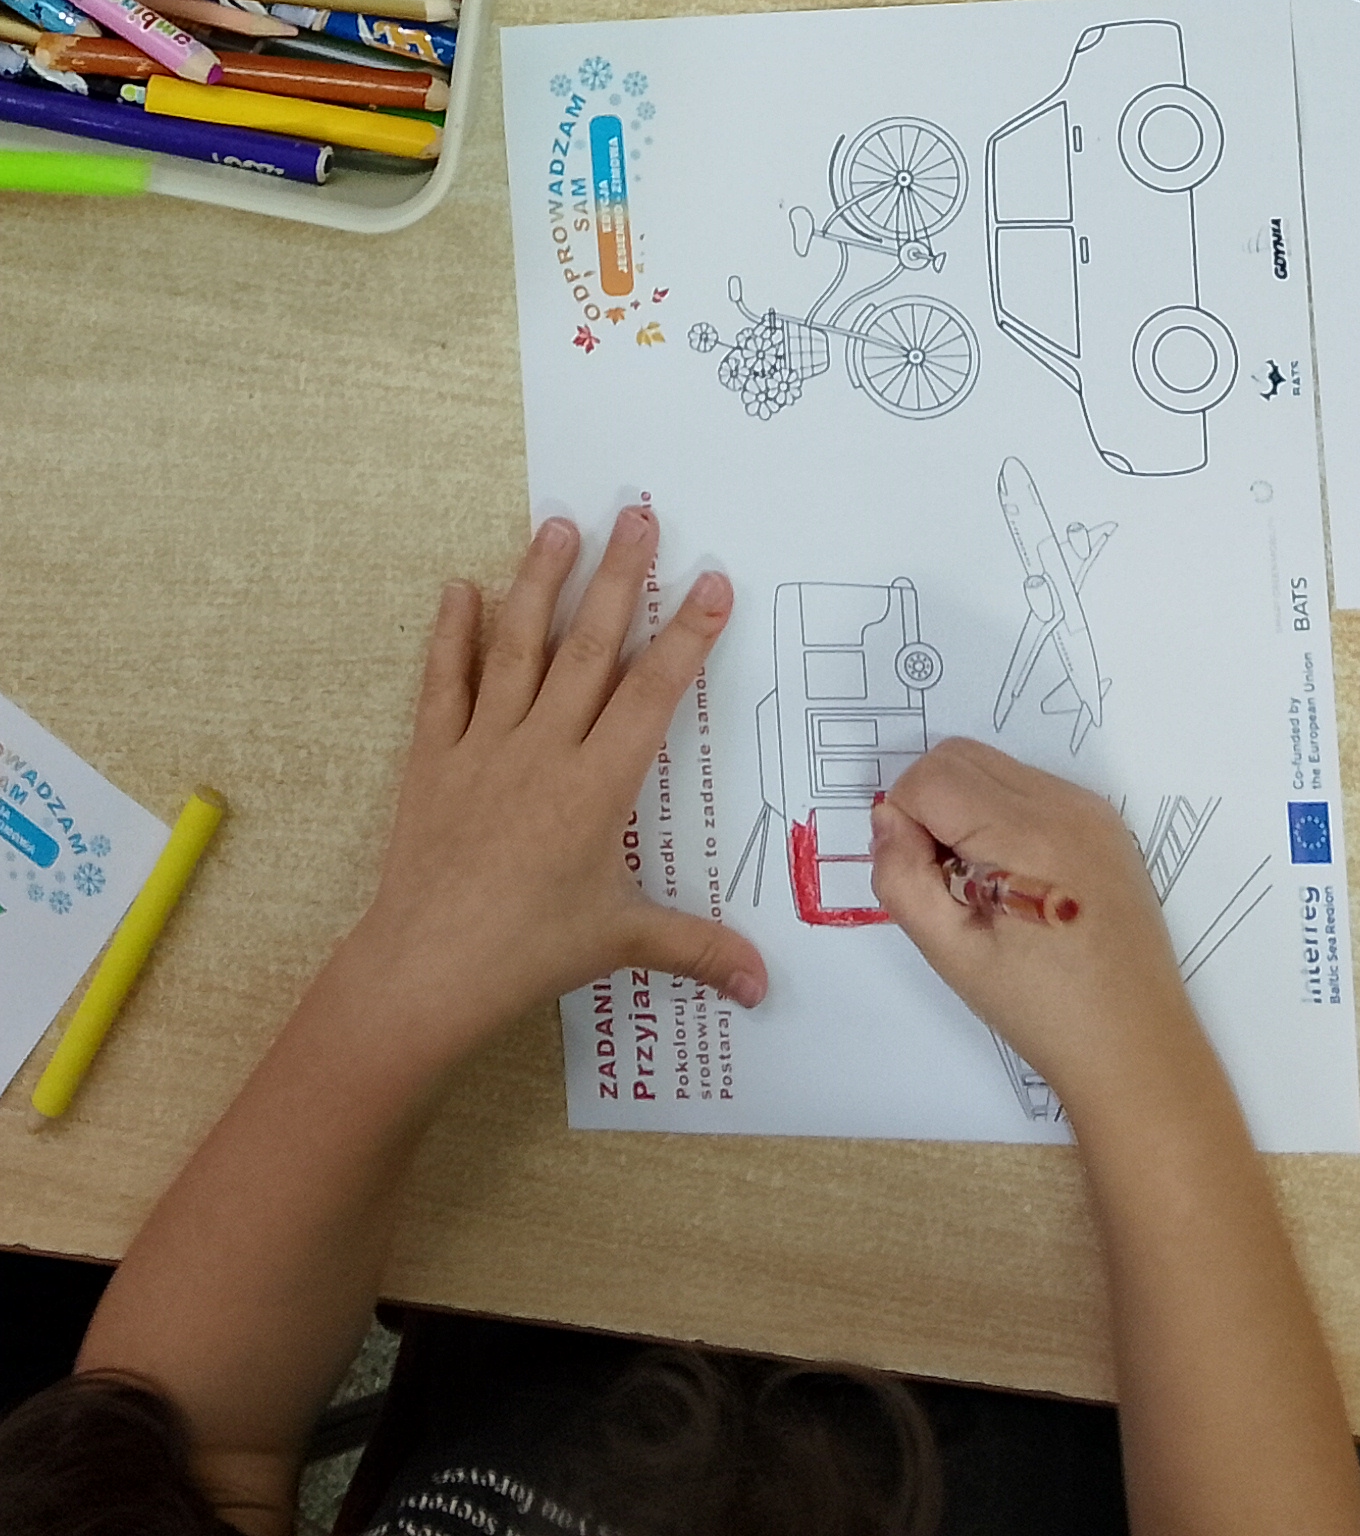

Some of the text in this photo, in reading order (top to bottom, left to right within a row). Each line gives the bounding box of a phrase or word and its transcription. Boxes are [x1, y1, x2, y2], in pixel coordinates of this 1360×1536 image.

[547, 92, 600, 321] ODPROWADZAM
[570, 176, 590, 232] SAM
[1270, 217, 1289, 281] GDYNIA
[1289, 576, 1312, 633] BATS
[1287, 696, 1306, 791] Co-funded by
[1303, 651, 1323, 791] the European Union
[698, 743, 716, 830] zadanie
[703, 836, 719, 859] to
[1293, 884, 1324, 1005] Interreg
[592, 983, 620, 1101] ZADANI
[627, 970, 660, 1101] Przyjaz
[671, 996, 692, 1101] Pokoloruj
[716, 1009, 735, 1101] Postaraj
